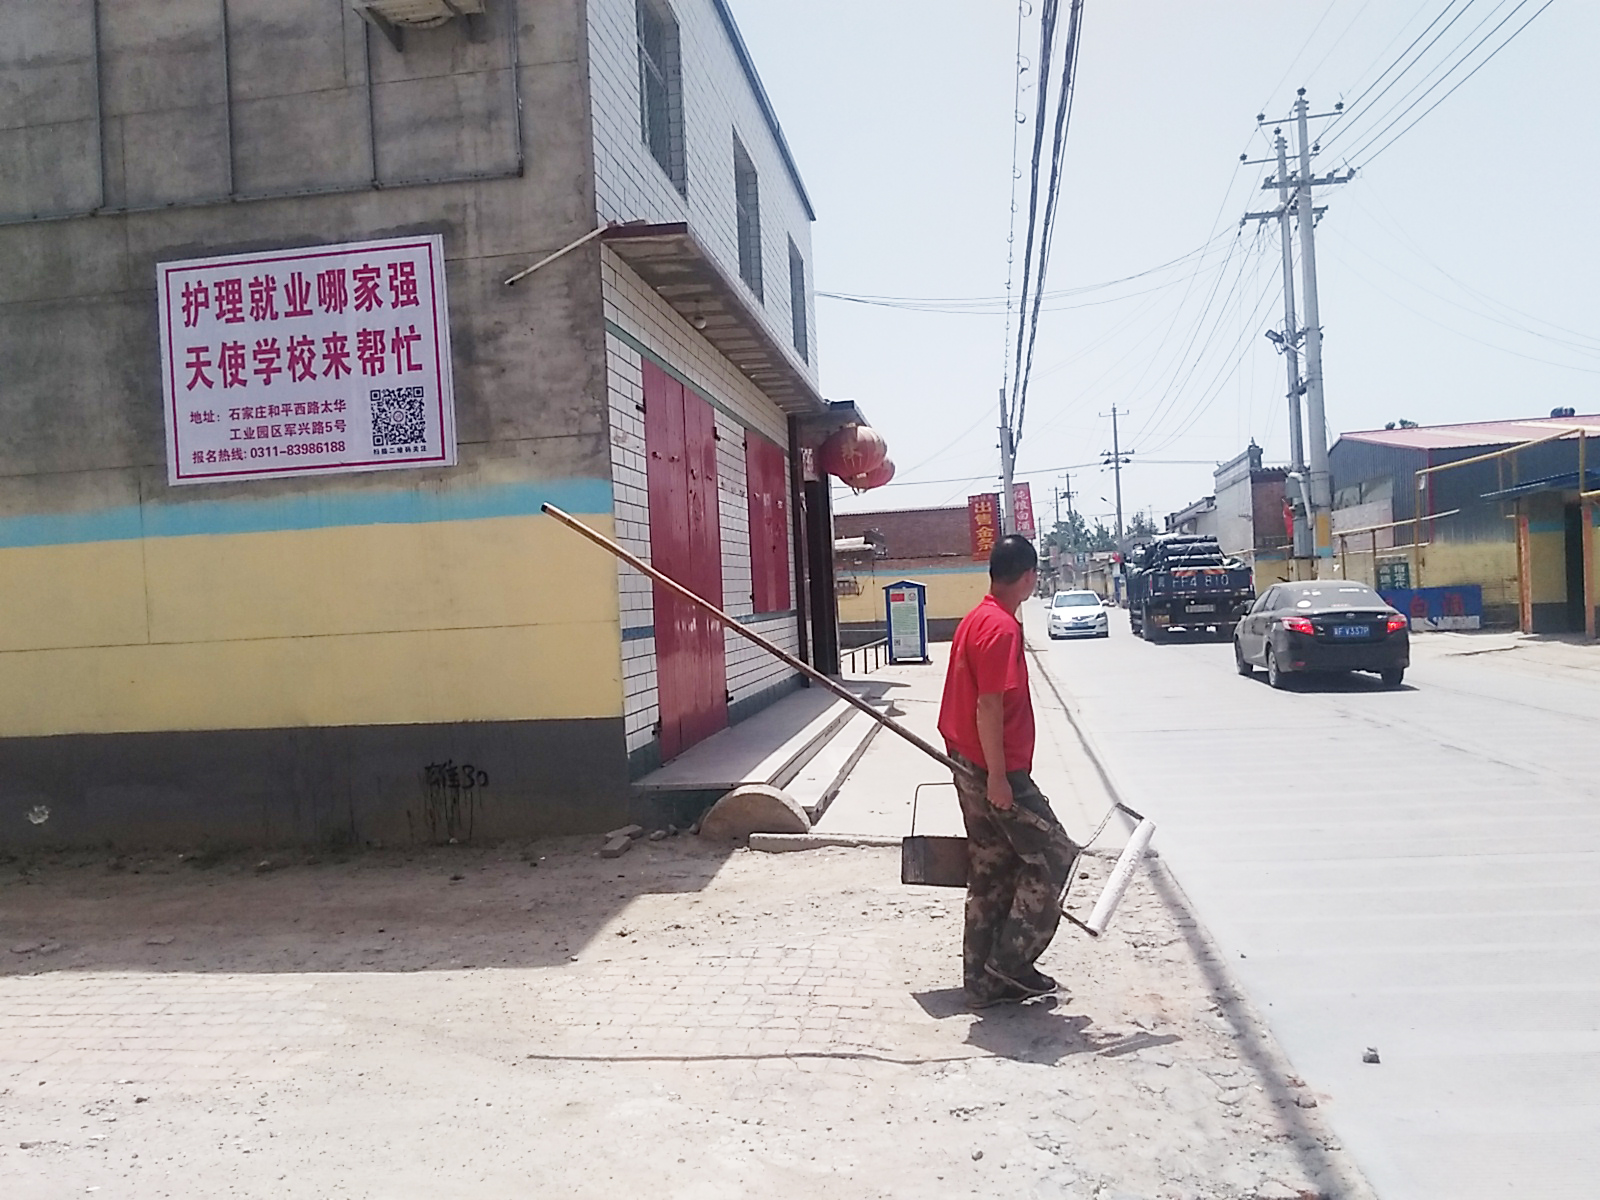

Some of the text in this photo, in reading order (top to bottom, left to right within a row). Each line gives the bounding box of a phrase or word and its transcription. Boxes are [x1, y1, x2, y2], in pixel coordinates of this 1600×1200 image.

[181, 261, 421, 328] 护理就业哪家强
[185, 324, 423, 391] 天使学校来帮忙
[229, 399, 347, 421] 石家庄和平西路太华
[229, 419, 347, 441] 工业园区军兴路5号
[250, 440, 346, 459] 0311-83986188
